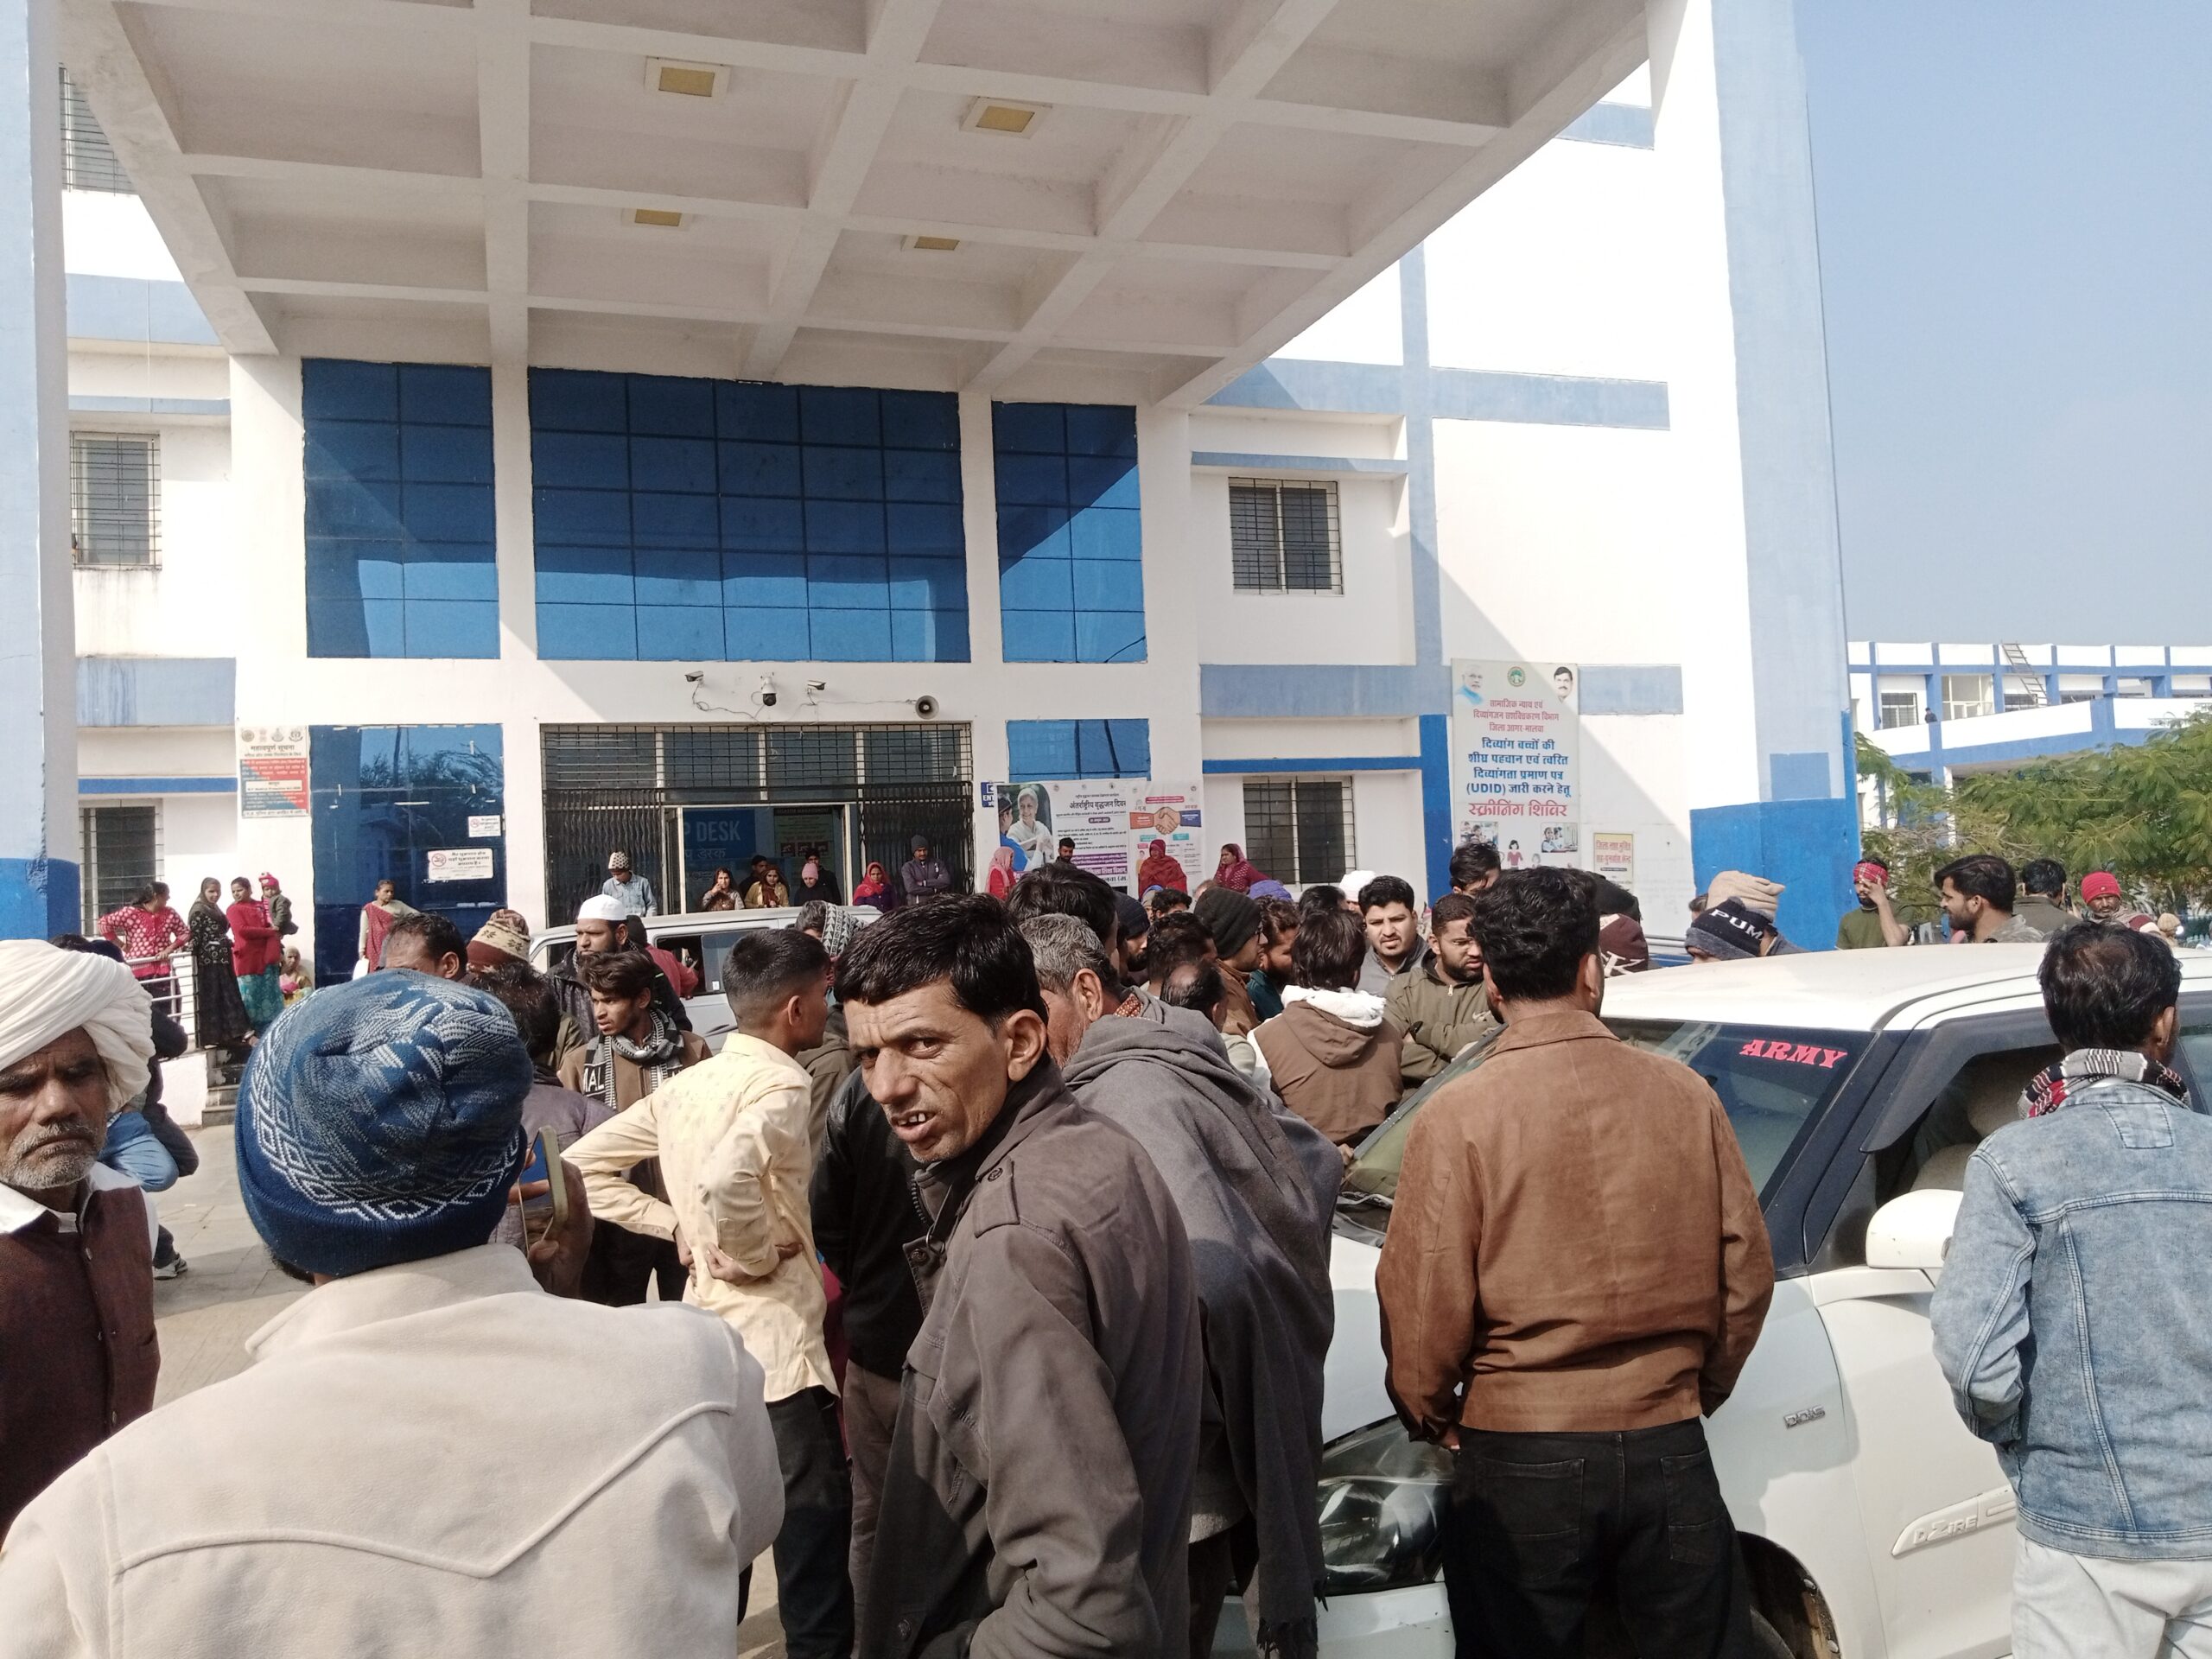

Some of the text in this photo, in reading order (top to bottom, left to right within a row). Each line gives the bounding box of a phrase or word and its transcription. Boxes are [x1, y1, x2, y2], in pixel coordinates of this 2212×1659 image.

[1473, 709, 1503, 720] दिव्यांगजन
[1489, 722, 1505, 732] जिला
[1482, 737, 1555, 750] दिव्यांग बच्चों की
[1468, 751, 1568, 765] शीघ्र पहचान एवं त्वरित
[1473, 766, 1564, 780] दिव्यांगता प्रमाण पत्र
[1466, 783, 1506, 795] (UDID)
[1508, 782, 1529, 793] जारी
[1532, 782, 1554, 793] करने
[1468, 798, 1567, 816] स्क्रीनिंग शिविर
[696, 821, 741, 842] DESK
[697, 846, 727, 859] डेस्क
[1709, 909, 1764, 940] PUM
[1738, 1039, 1848, 1069] ARMY
